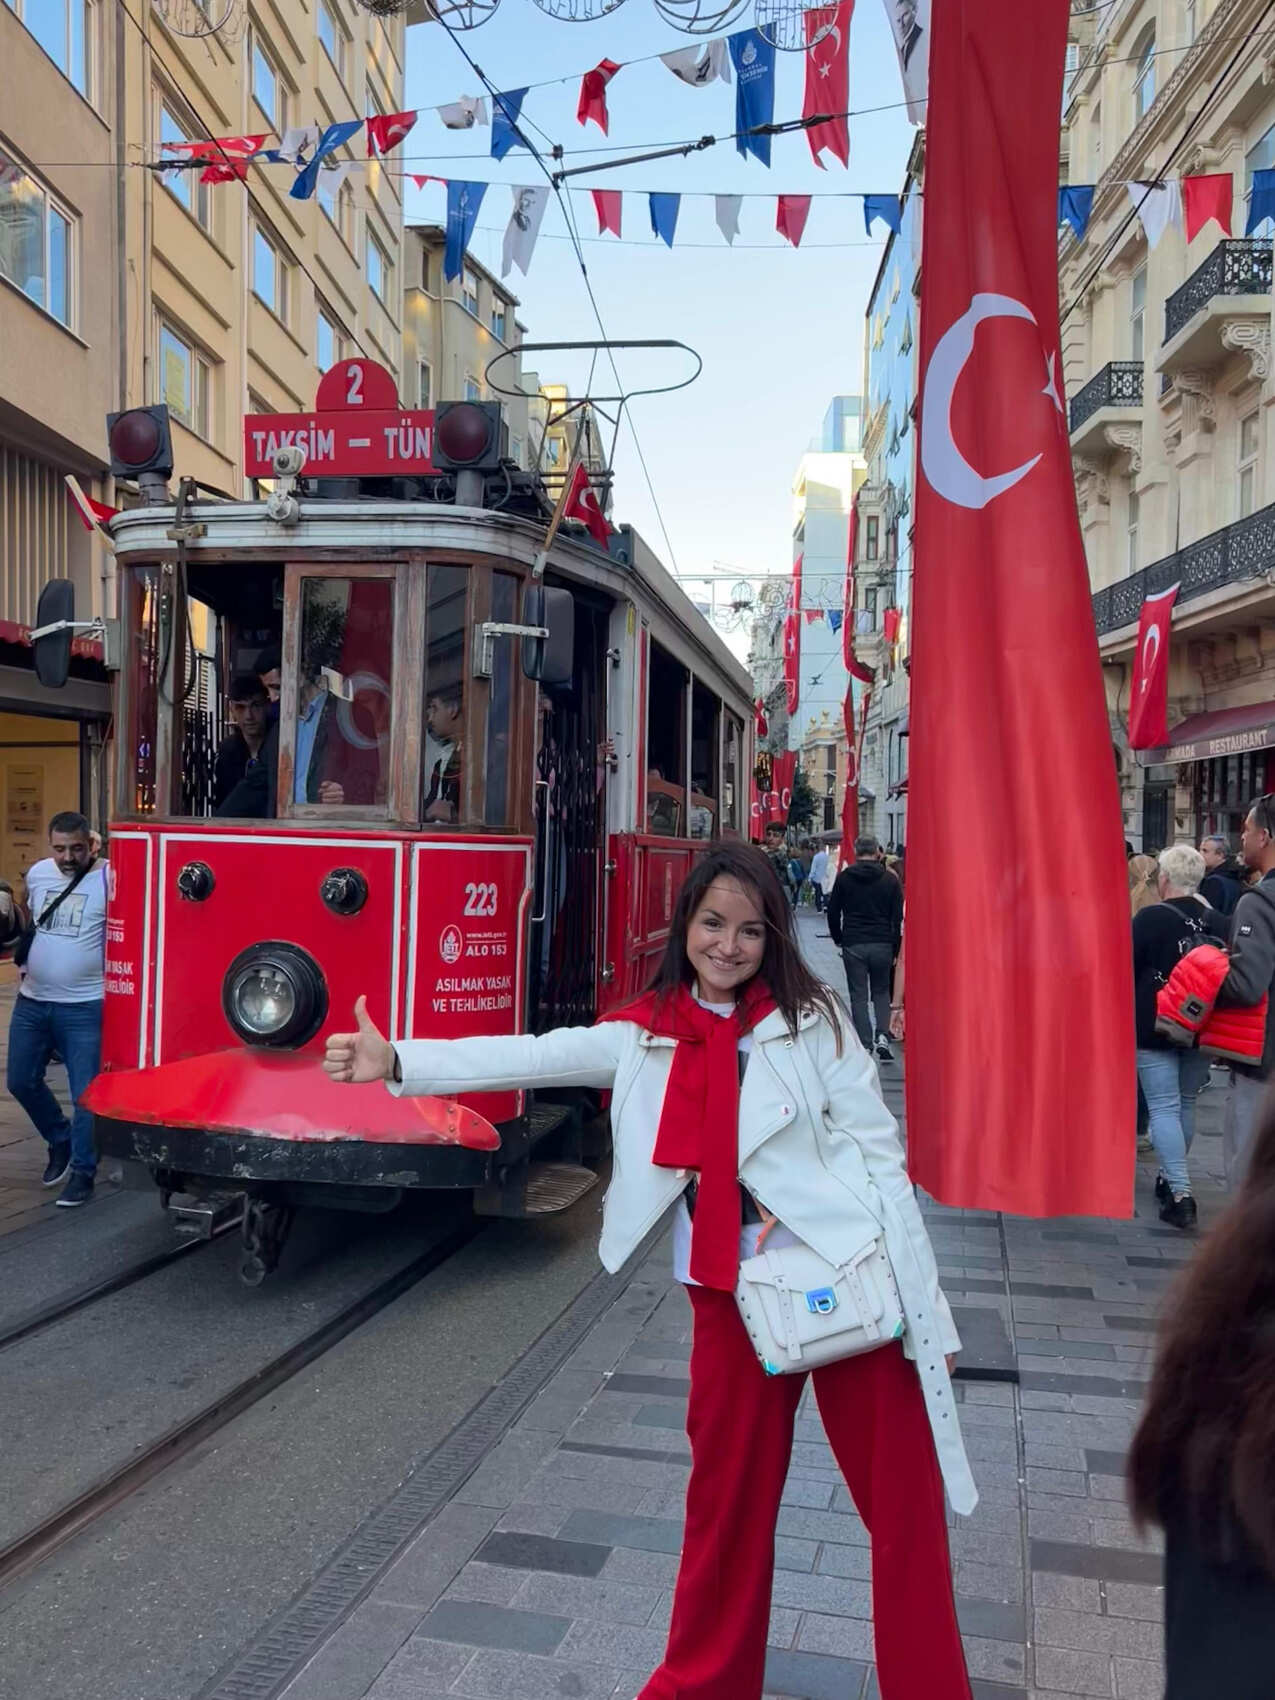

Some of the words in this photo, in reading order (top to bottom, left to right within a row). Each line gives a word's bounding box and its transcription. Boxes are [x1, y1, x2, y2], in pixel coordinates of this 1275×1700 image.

[347, 364, 364, 404] 2
[253, 421, 335, 462] TAKSİM
[384, 418, 435, 460] TÜN
[1209, 730, 1267, 754] RESTAURANT
[464, 882, 498, 917] 223
[465, 945, 489, 957] ALO
[491, 944, 507, 956] 153
[435, 977, 485, 993] ASILMAK
[486, 975, 512, 990] YASAK
[432, 998, 447, 1013] VE
